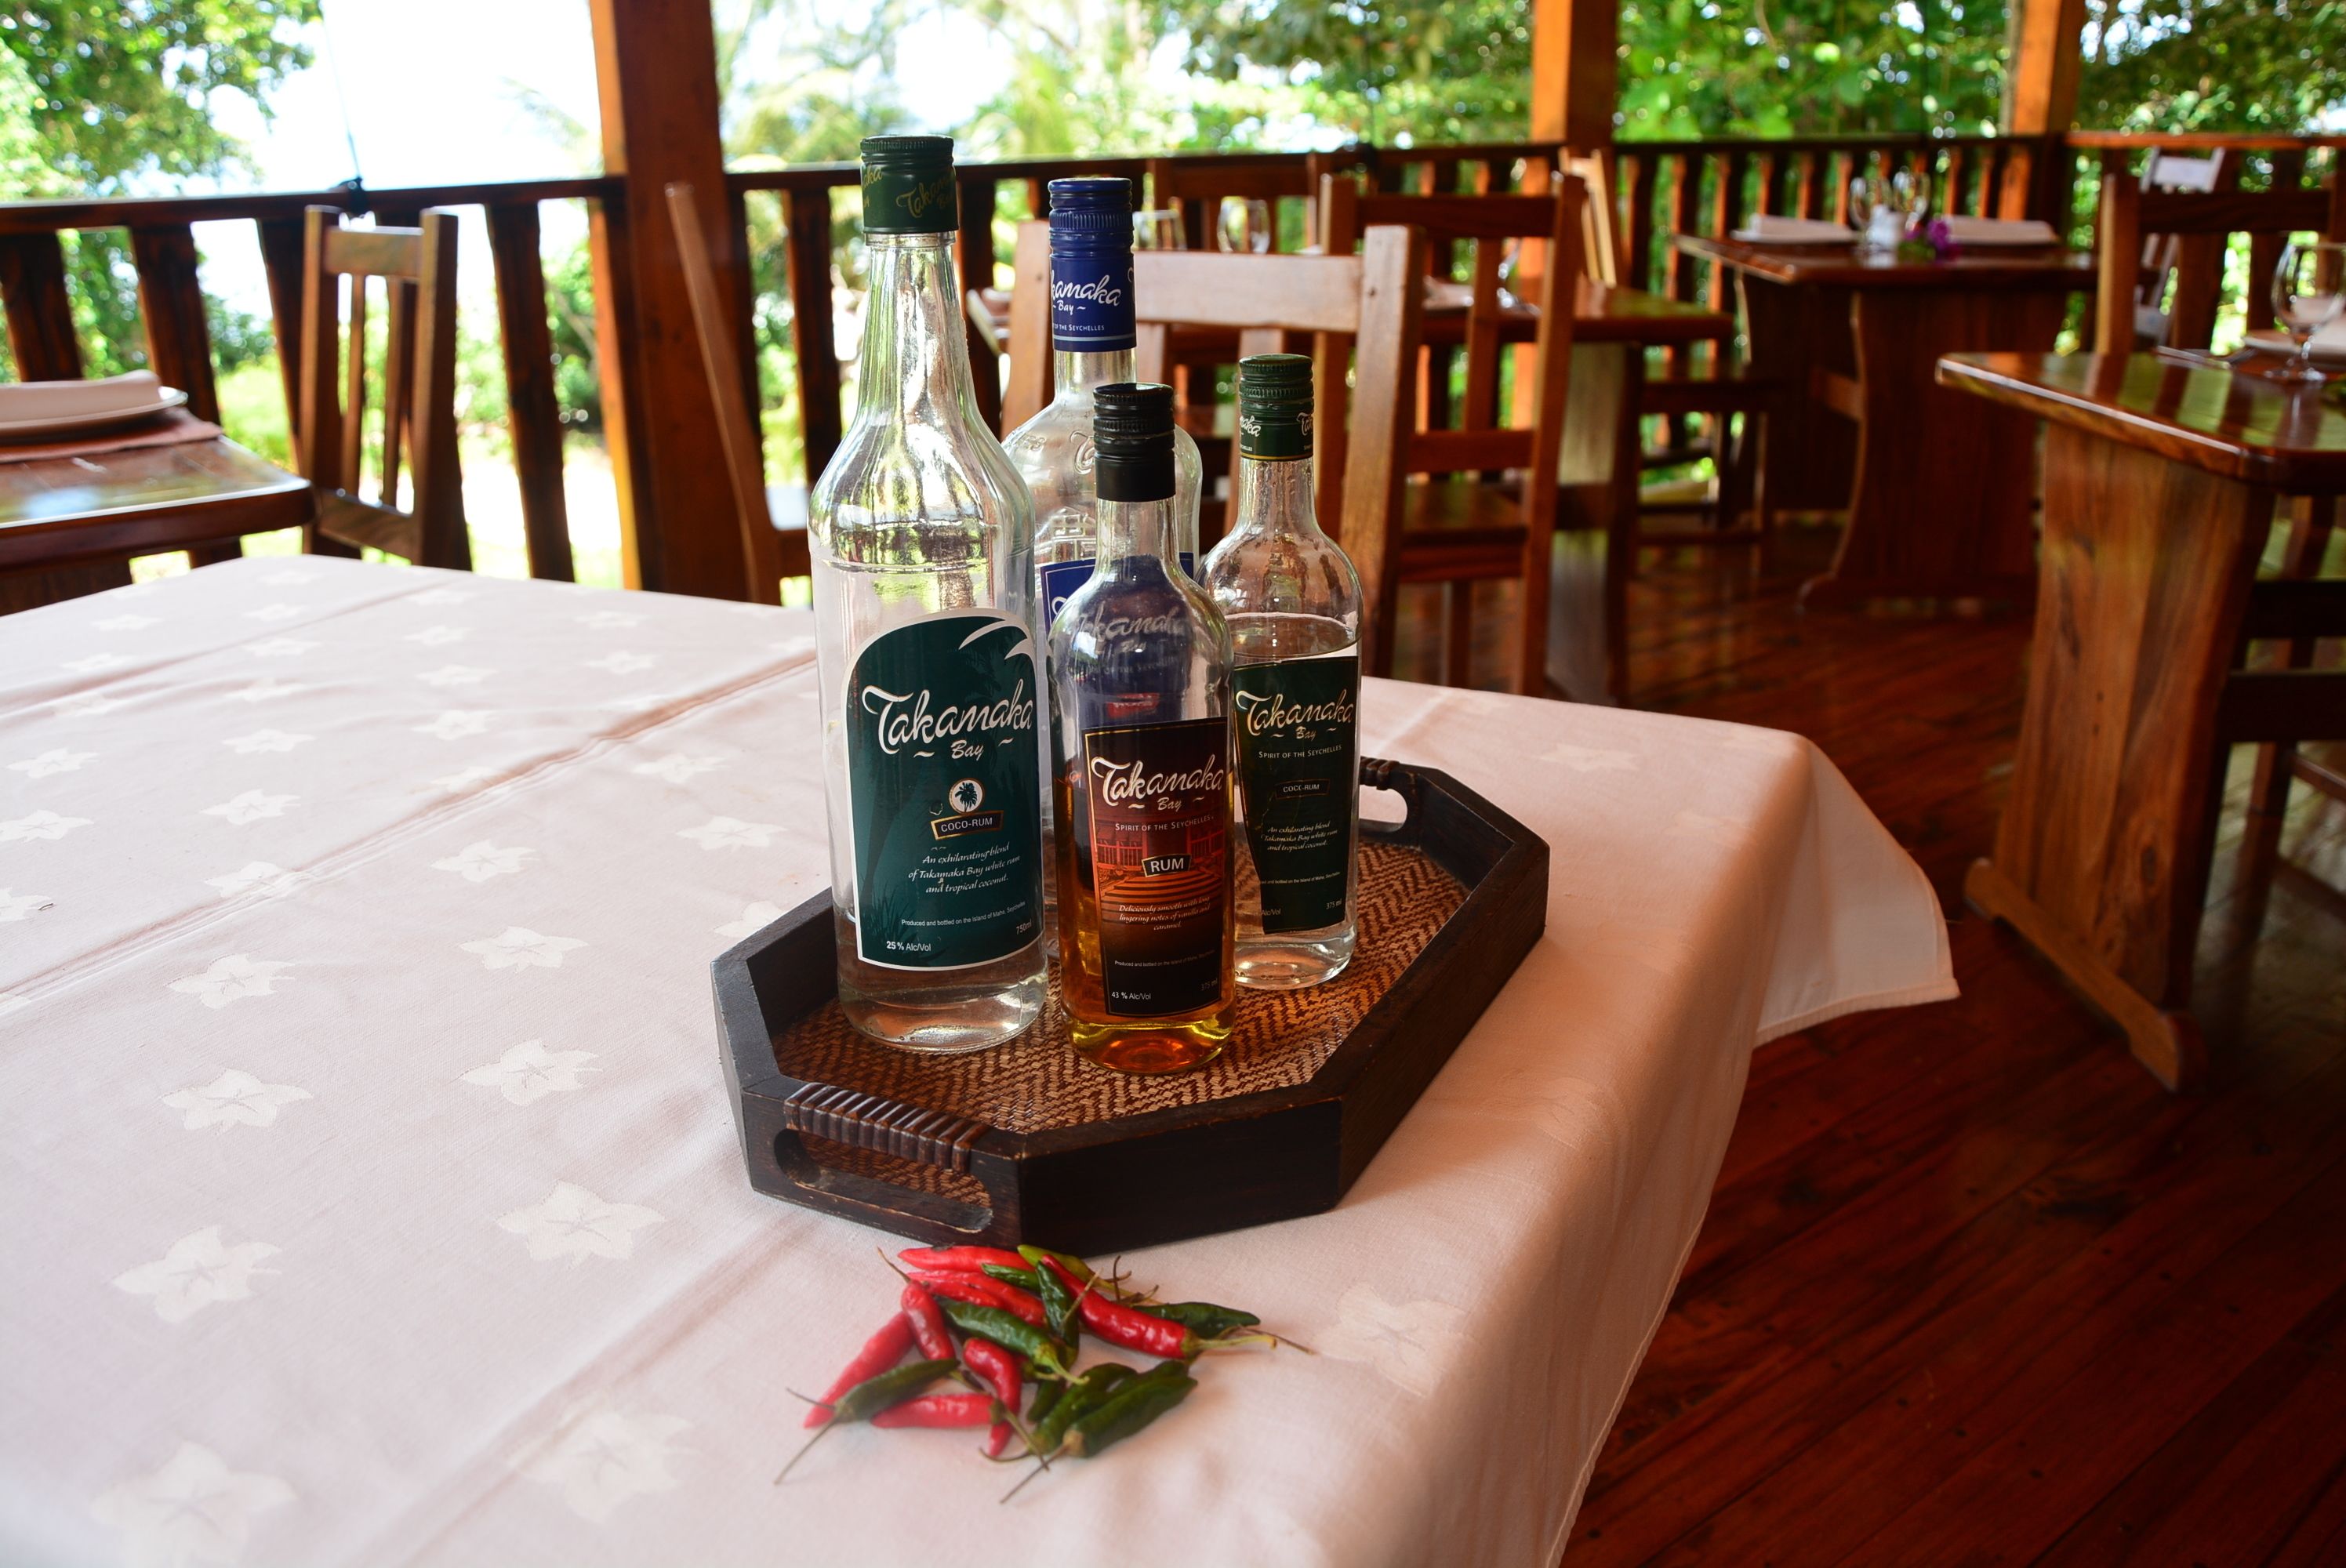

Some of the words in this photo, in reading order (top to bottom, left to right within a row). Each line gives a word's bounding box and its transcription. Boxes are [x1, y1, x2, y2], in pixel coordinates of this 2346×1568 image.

[1057, 299, 1074, 315] Bay
[862, 678, 1033, 755] Takamaka
[1236, 688, 1353, 736] Takamaka
[1295, 725, 1317, 741] Bay
[950, 739, 984, 760] Bay
[1308, 745, 1342, 757] SEYCHELLES
[1091, 754, 1224, 807] Takamaka
[1157, 797, 1182, 812] Bay
[941, 817, 993, 833] COCO-RUM
[1115, 822, 1138, 831] SPIRIT
[922, 855, 936, 864] An
[938, 850, 990, 865] exhilarating
[990, 841, 1010, 856] blend
[908, 869, 920, 882] of
[919, 867, 964, 880] Takamaka
[967, 866, 983, 877] Bay
[985, 860, 1005, 872] white
[1006, 855, 1020, 866] rum
[1150, 858, 1184, 873] RUM
[925, 883, 943, 894] and
[945, 879, 978, 895] tropical
[1119, 904, 1157, 915] Deliciously
[1119, 913, 1149, 924] lingering
[1016, 920, 1032, 935] 750ml
[886, 941, 896, 949] 25
[896, 942, 904, 951] %
[906, 942, 932, 952] Alc/Vol
